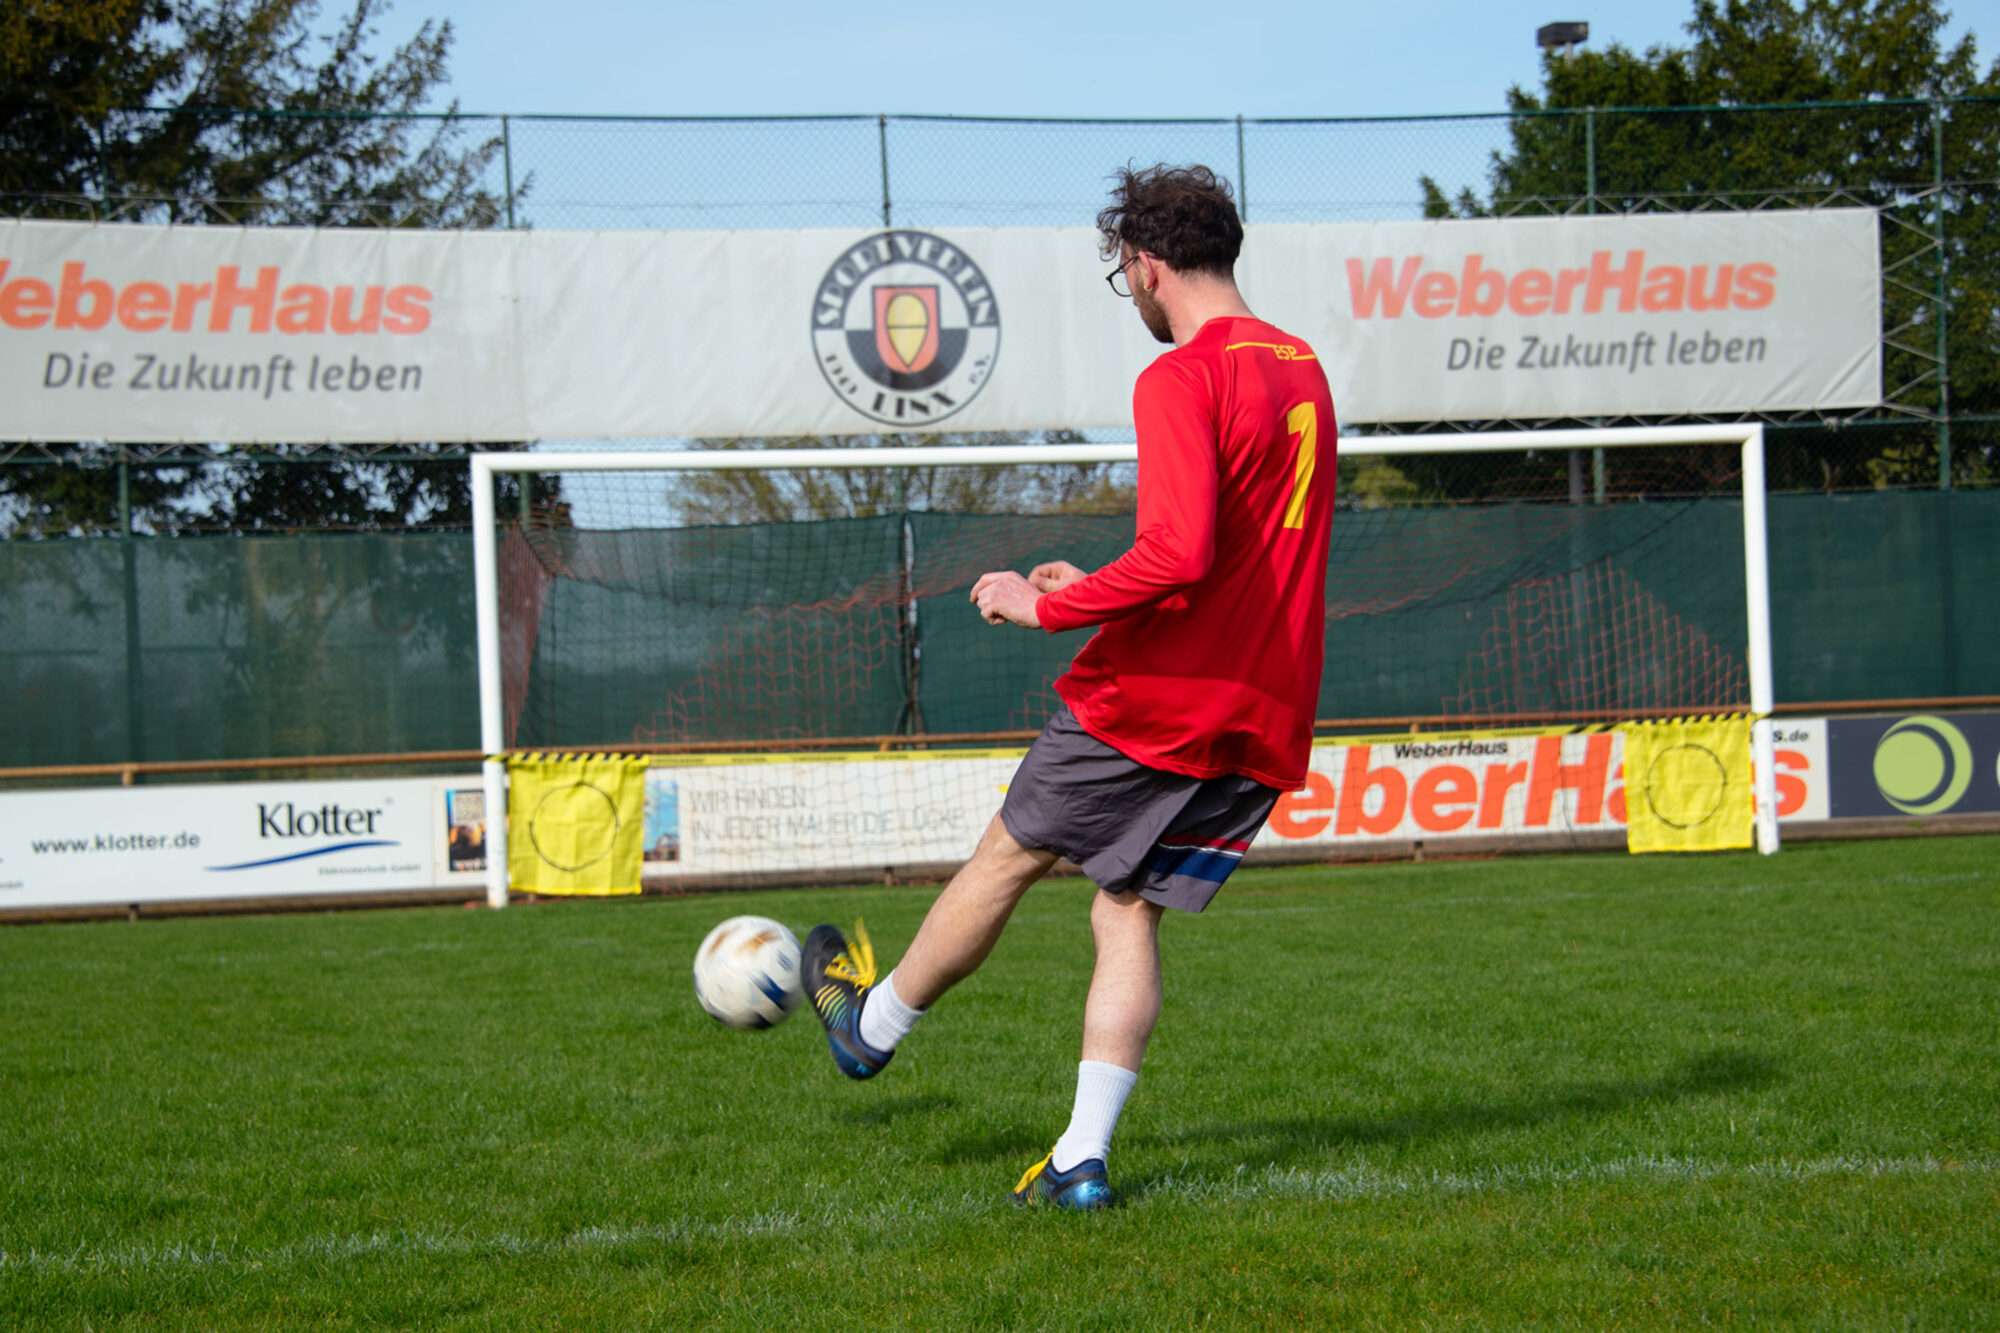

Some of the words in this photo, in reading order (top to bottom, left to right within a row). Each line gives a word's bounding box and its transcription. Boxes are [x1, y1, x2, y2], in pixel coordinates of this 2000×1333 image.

[0, 258, 434, 335] eberHaus
[1344, 249, 1777, 320] WeberHaus
[1273, 344, 1297, 361] ESP
[1446, 336, 1506, 371] Die
[1514, 331, 1657, 373] Zukunft
[1664, 329, 1768, 365] leben
[42, 352, 115, 390] Die
[127, 353, 296, 400] Zukunft
[307, 355, 424, 392] leben
[1393, 740, 1508, 759] WeberHaus
[690, 789, 729, 813] WIR
[257, 802, 383, 838] Klotter
[31, 831, 201, 855] www.klotter.de
